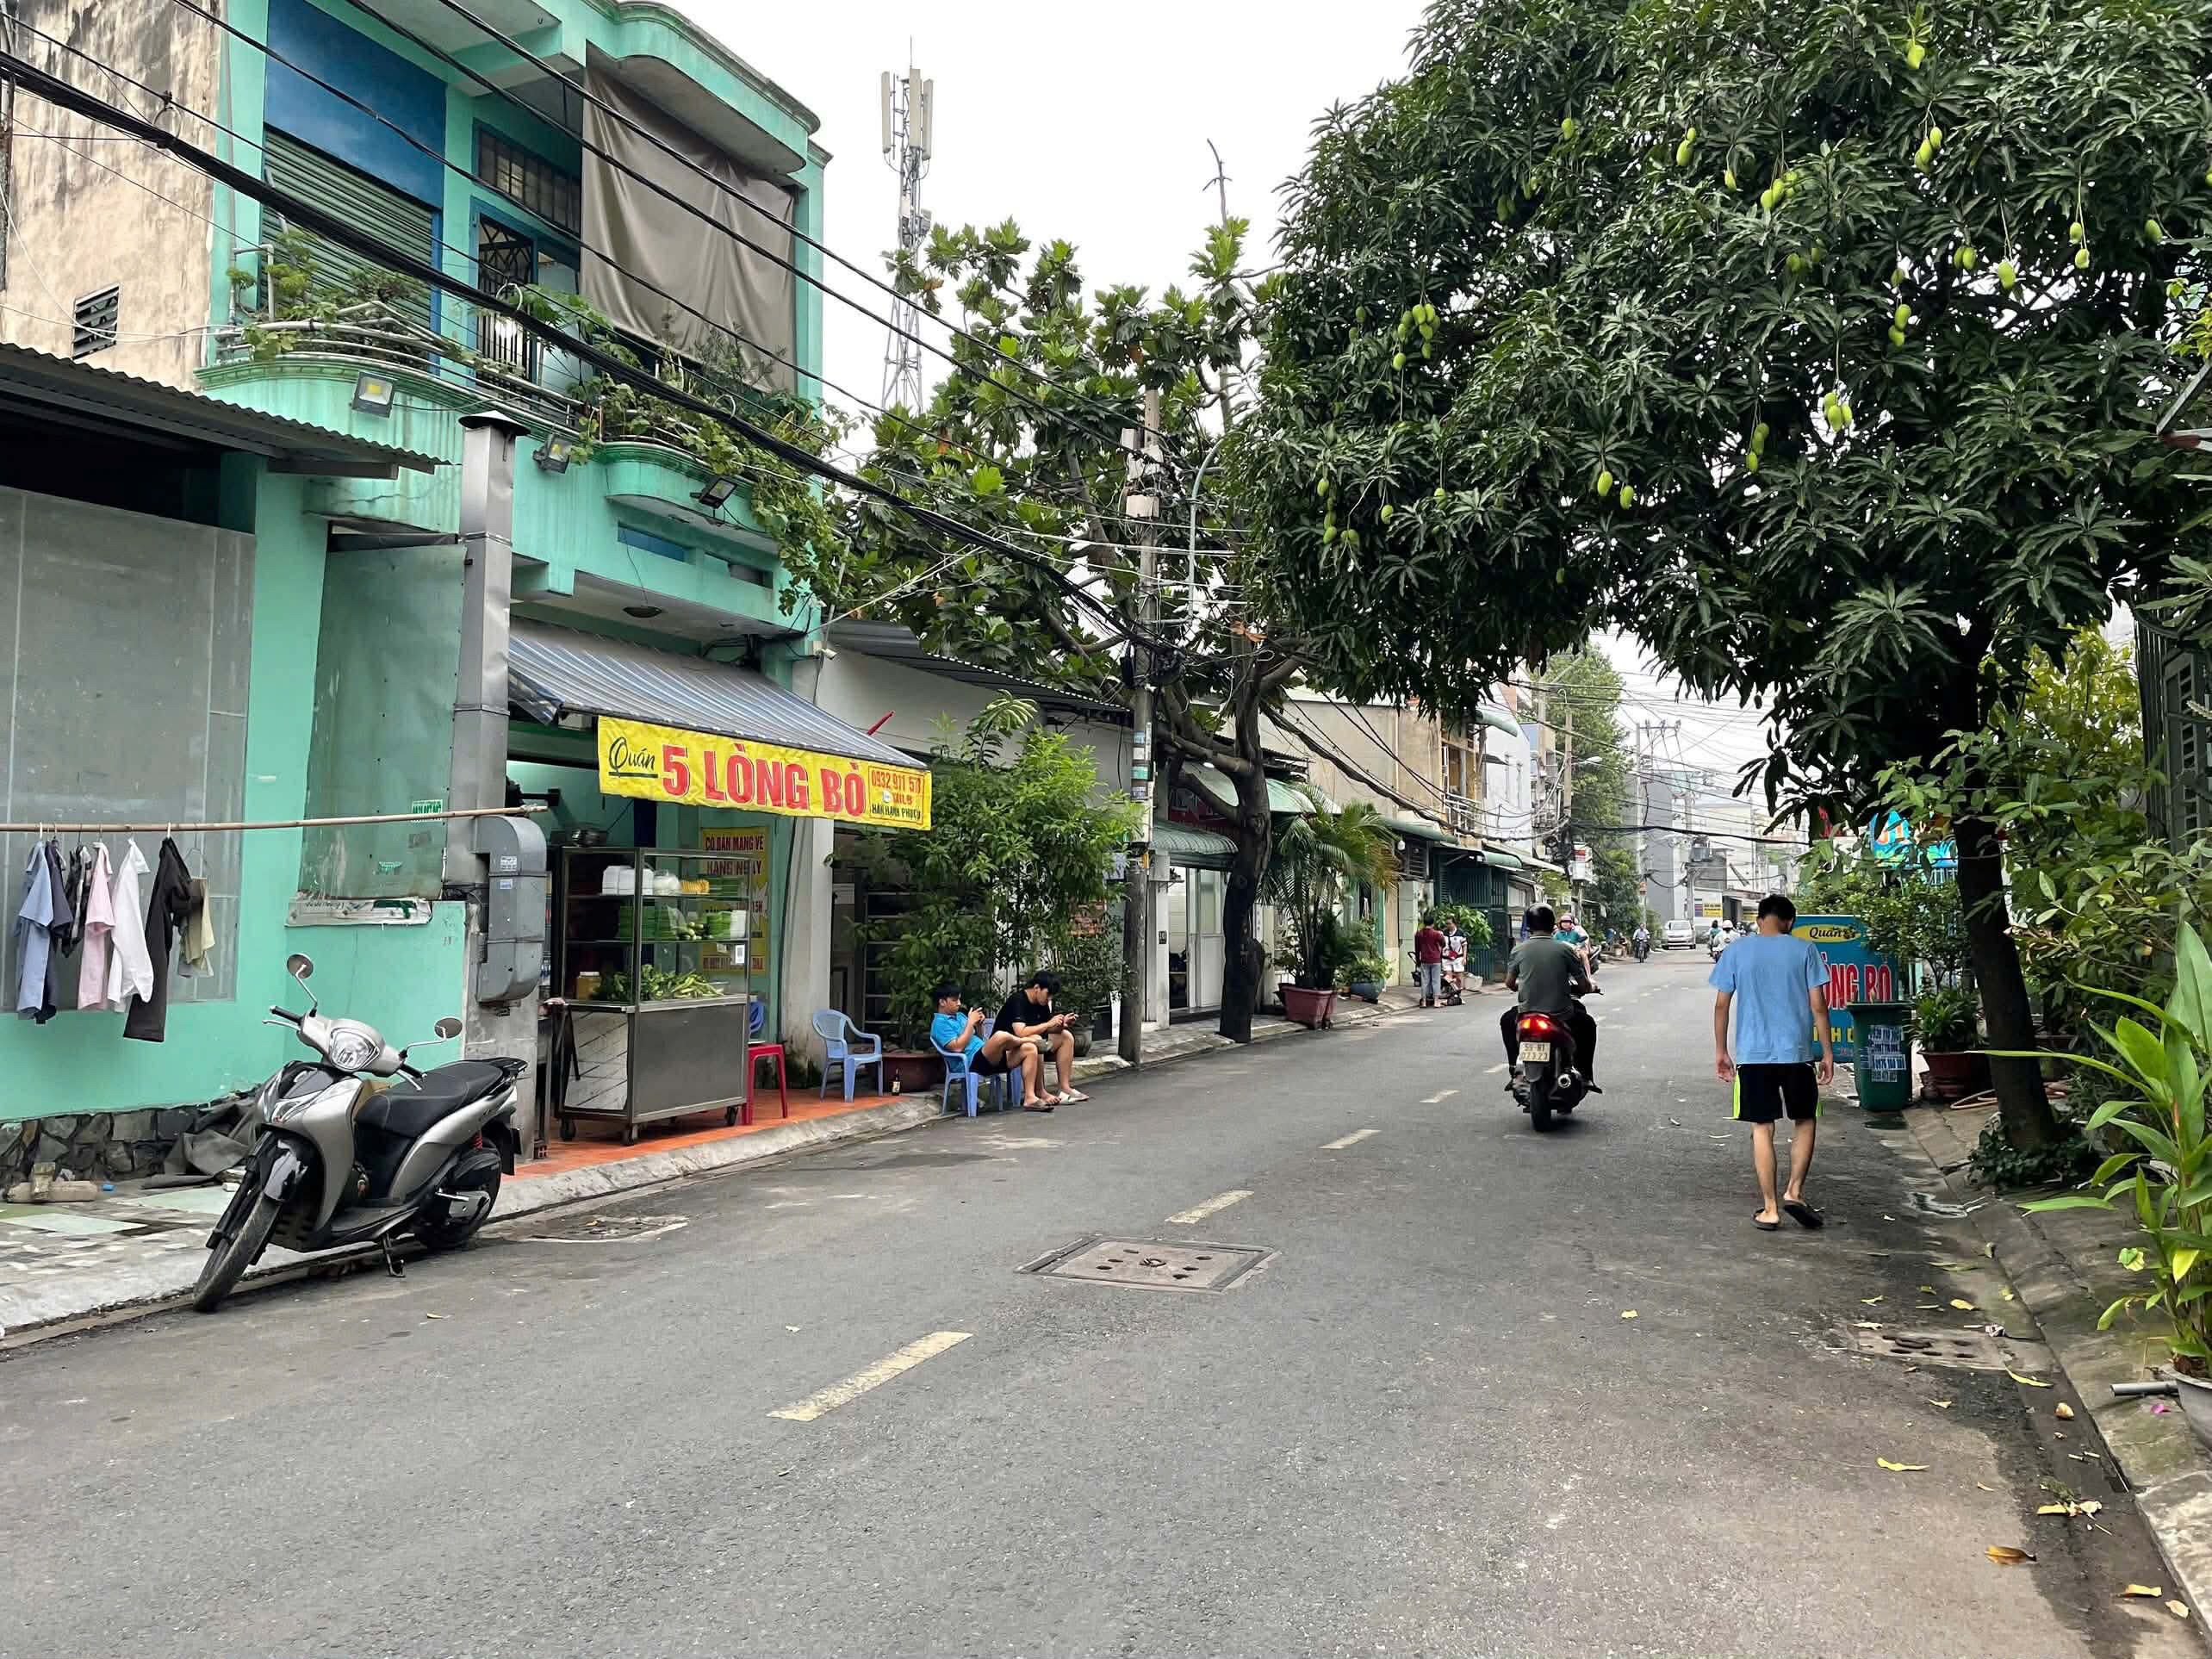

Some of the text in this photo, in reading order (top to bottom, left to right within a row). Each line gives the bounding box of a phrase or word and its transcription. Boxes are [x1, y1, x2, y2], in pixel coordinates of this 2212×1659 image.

[608, 736, 867, 817] Quán 5 LÒNG BÒ
